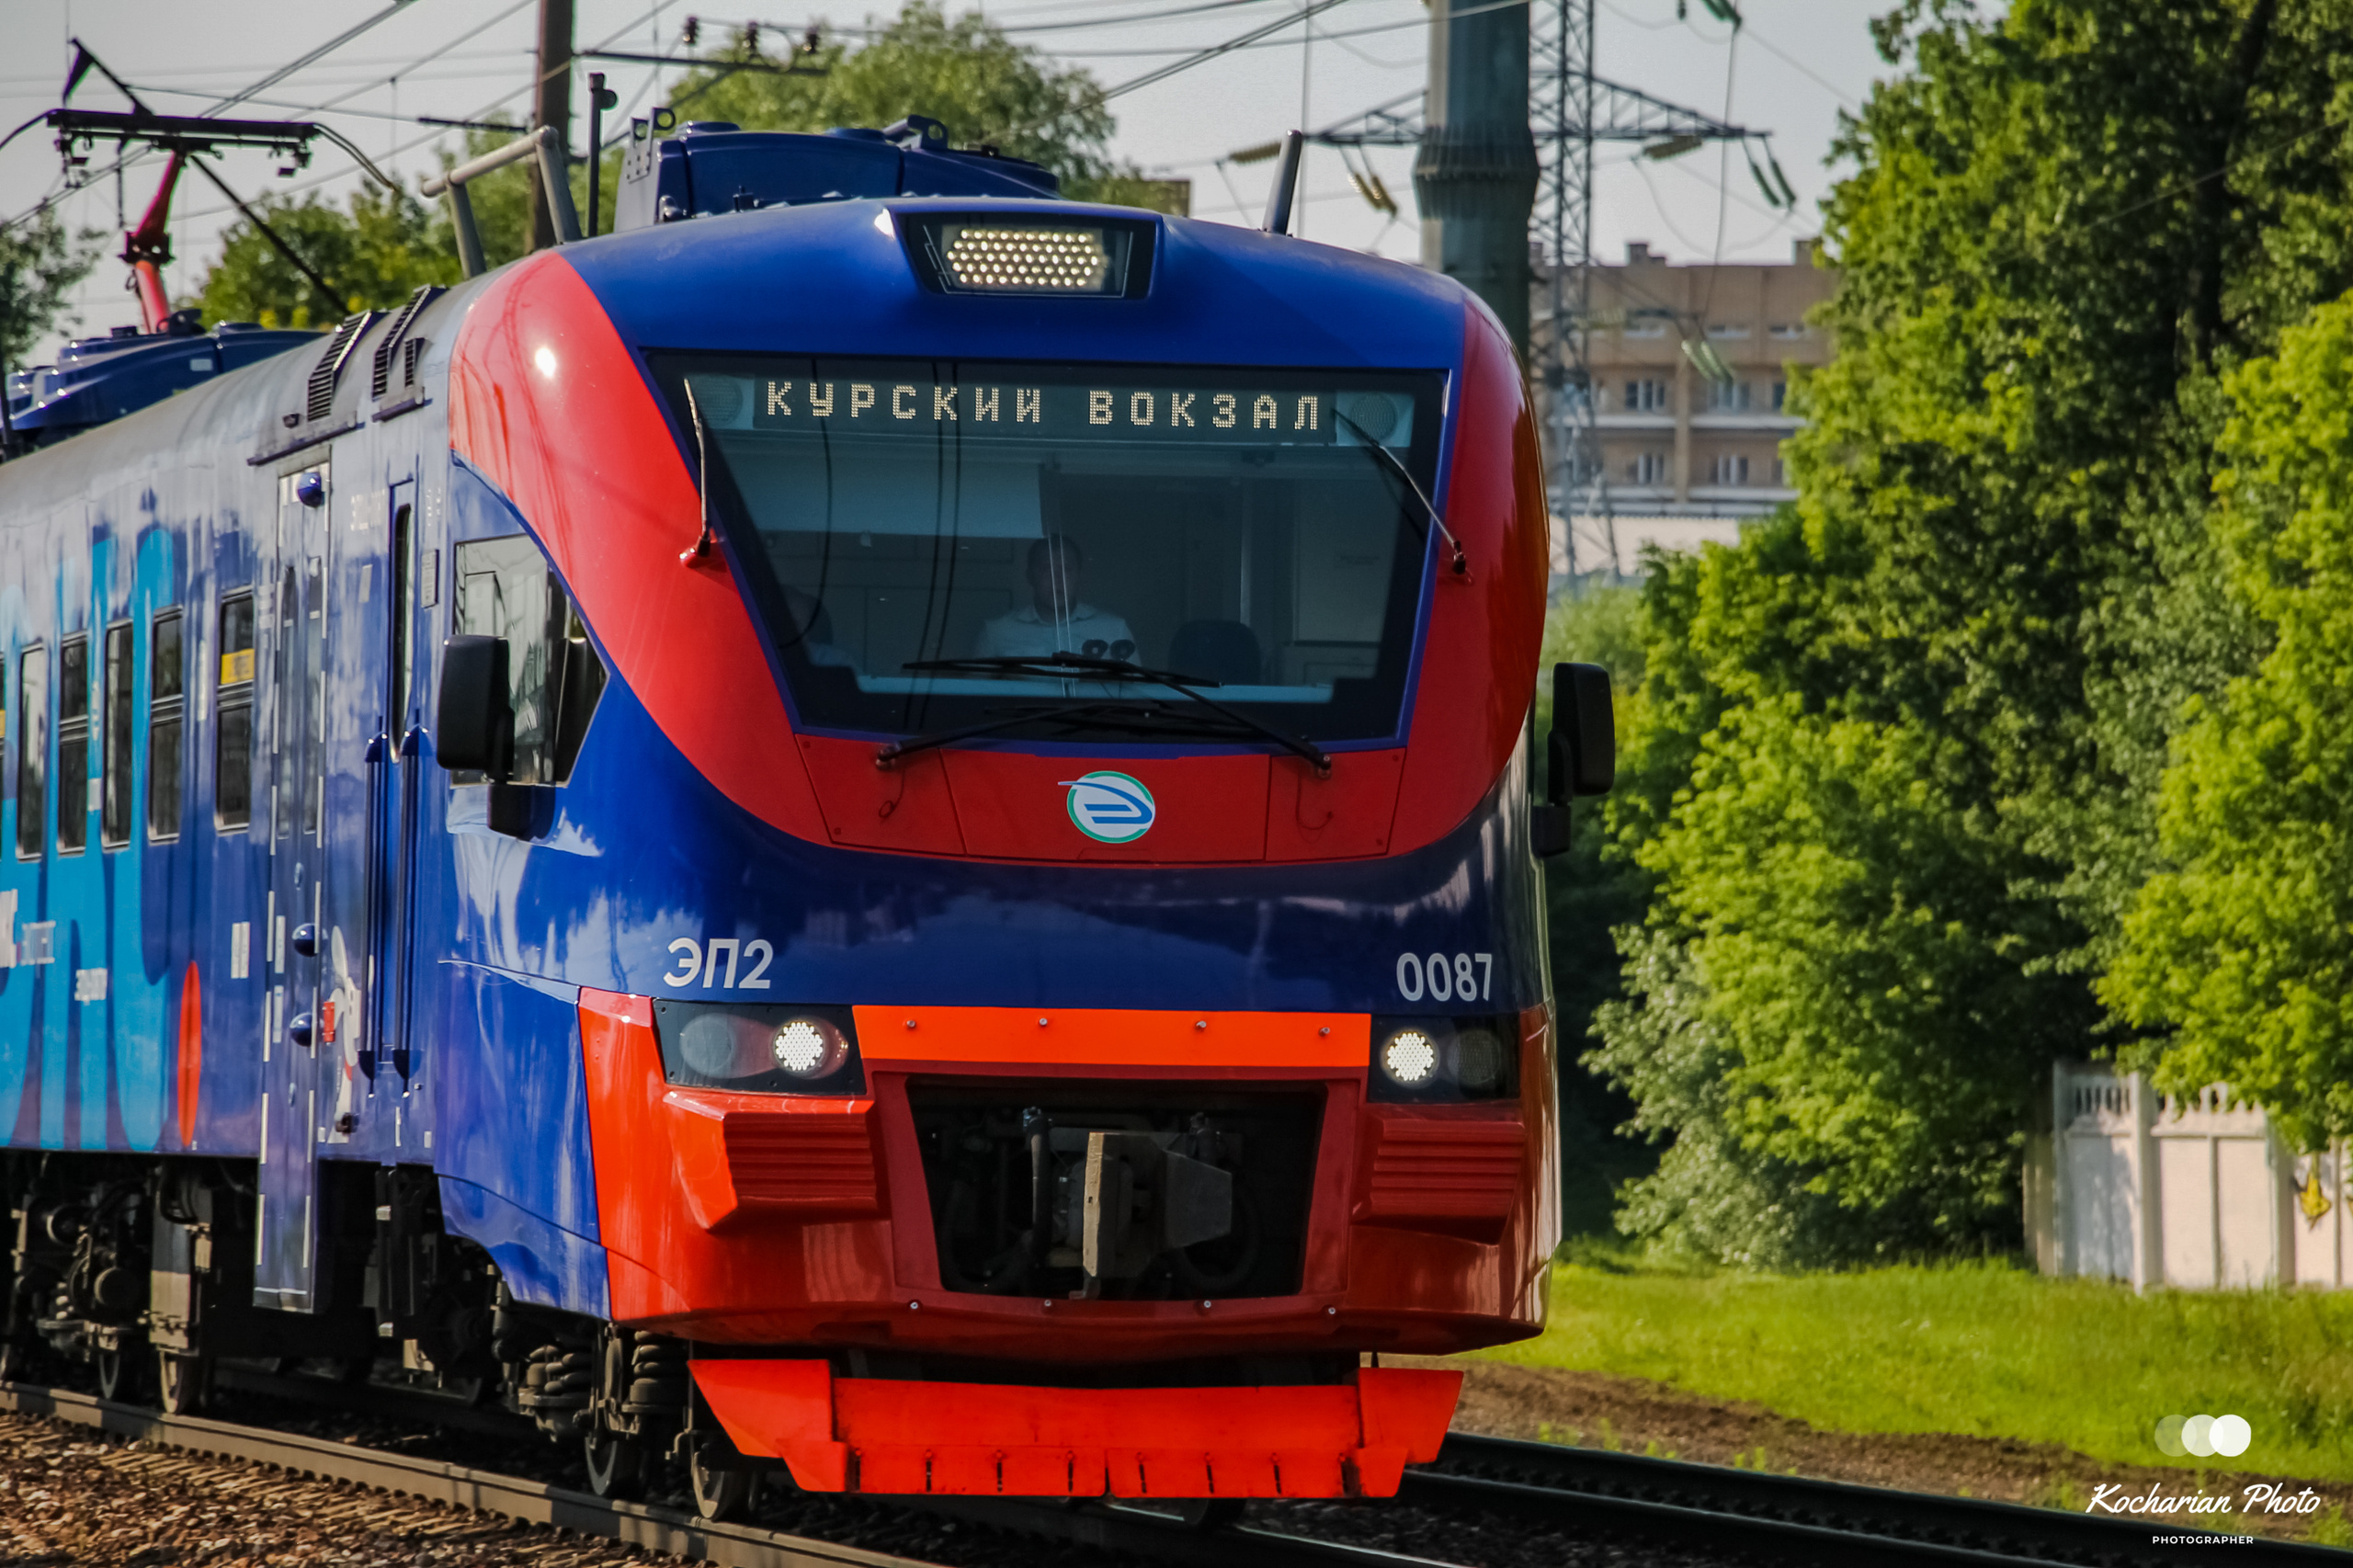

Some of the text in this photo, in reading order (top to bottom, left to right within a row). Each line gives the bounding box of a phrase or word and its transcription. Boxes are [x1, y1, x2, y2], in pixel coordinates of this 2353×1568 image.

[767, 381, 1319, 430] КУРСКИЙ ВОКЗАЛ
[663, 937, 774, 989] ЭП2
[1396, 952, 1495, 1002] 0087
